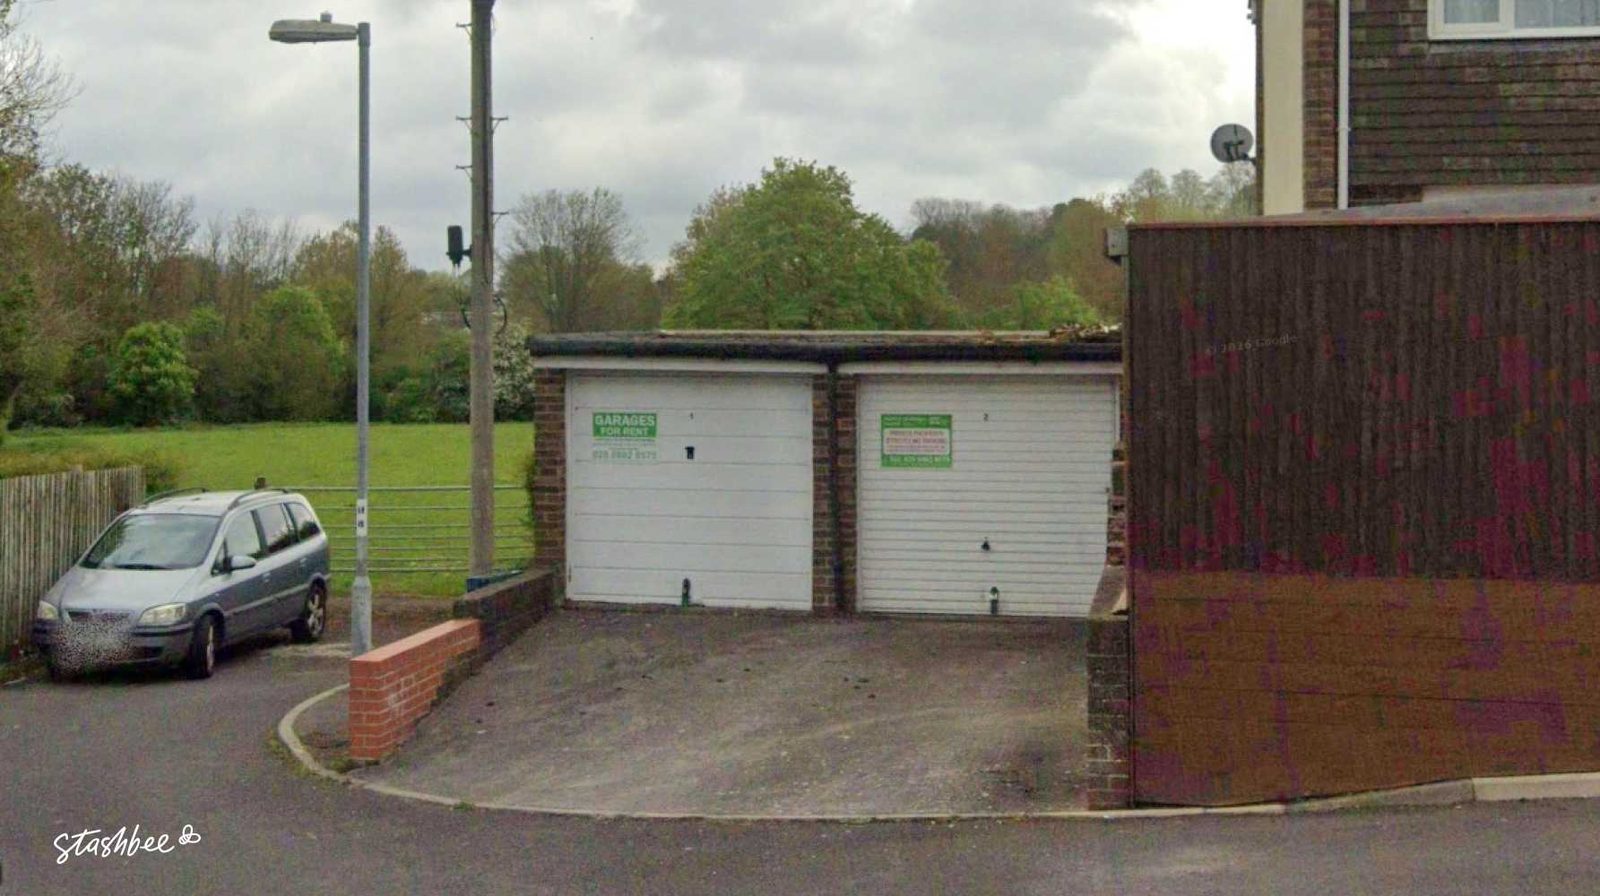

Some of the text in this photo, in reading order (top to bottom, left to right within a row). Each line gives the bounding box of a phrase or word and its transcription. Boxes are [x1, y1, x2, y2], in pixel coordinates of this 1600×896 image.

[594, 414, 655, 426] GARAGES
[983, 412, 989, 422] 2
[600, 427, 649, 436] FOR RENT
